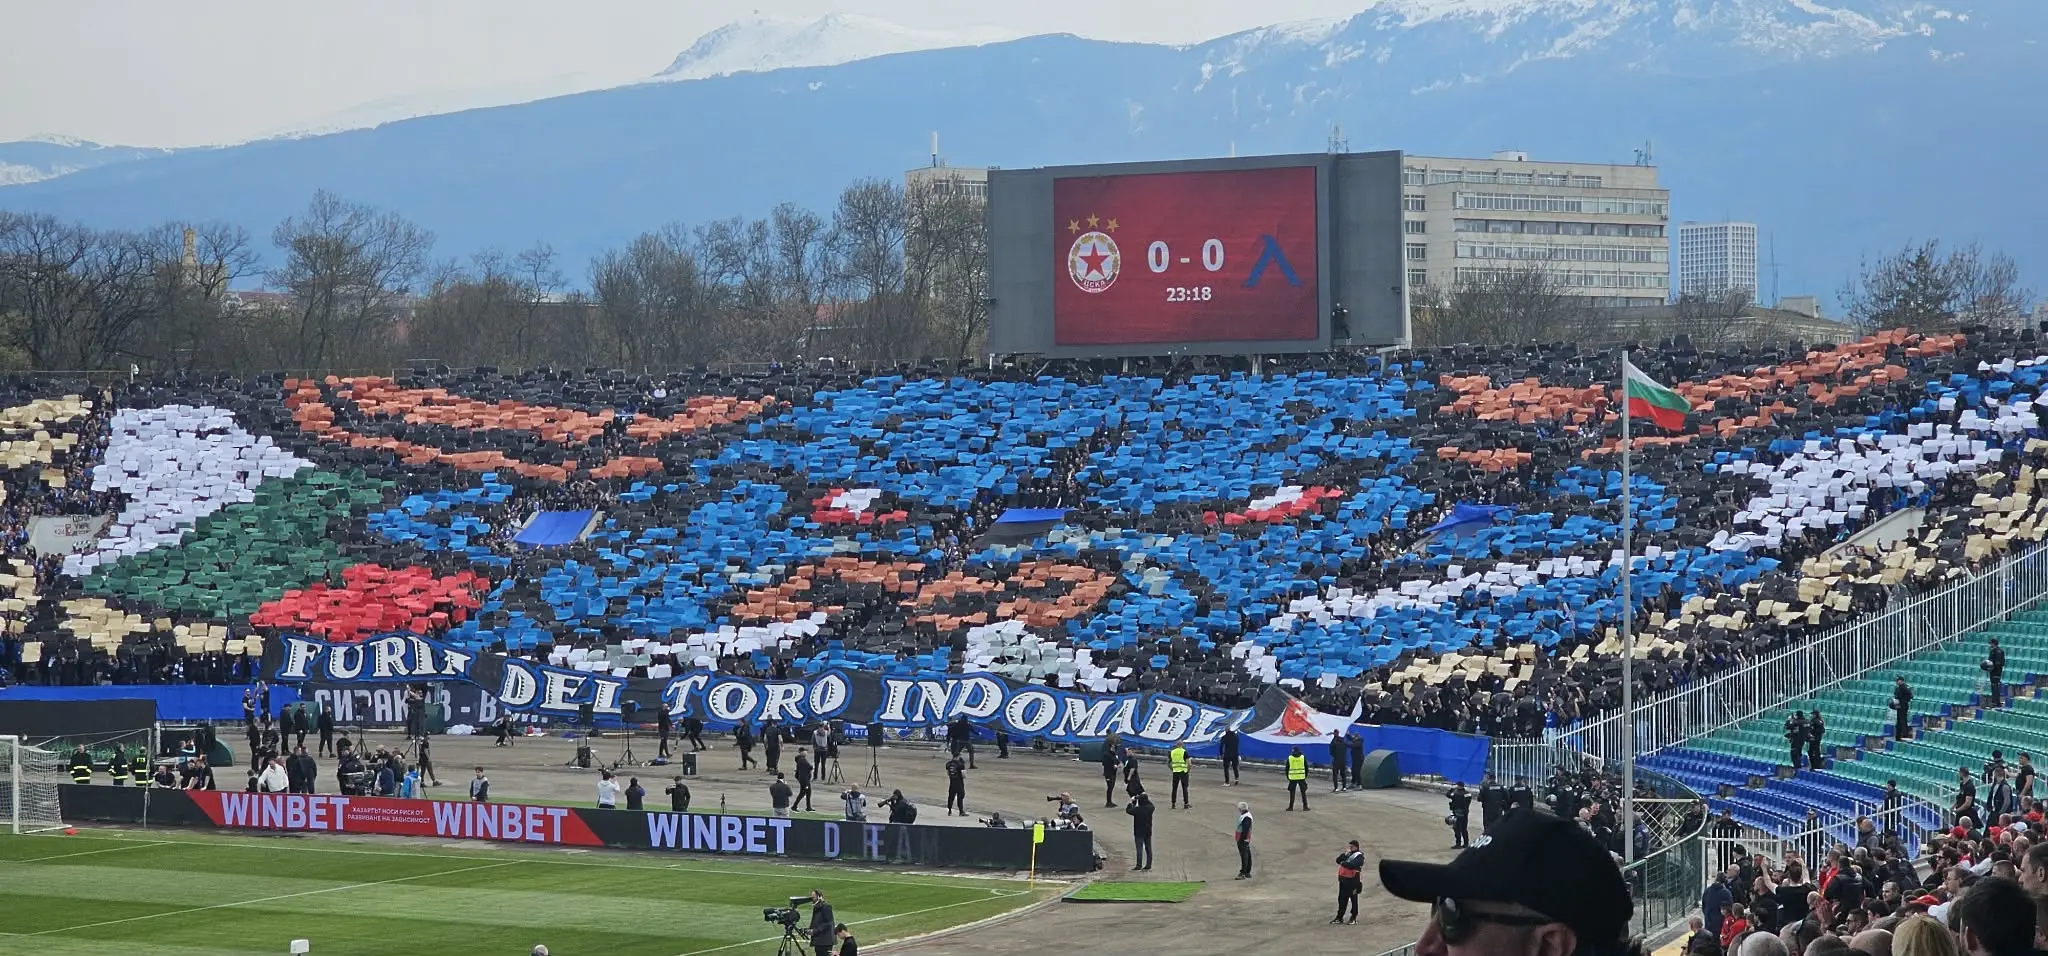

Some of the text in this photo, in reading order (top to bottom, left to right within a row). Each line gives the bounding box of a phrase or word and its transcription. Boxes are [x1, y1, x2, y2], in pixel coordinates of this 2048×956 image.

[1148, 240, 1170, 273] 0
[1202, 238, 1225, 272] 0
[1166, 286, 1212, 302] 23:18
[314, 688, 452, 722] СИРАКВ
[499, 664, 622, 714] DEL
[666, 673, 847, 721] TORO
[880, 677, 1253, 743] INDOMABL
[221, 792, 350, 830] WINBET
[432, 801, 569, 842] WINBET
[647, 812, 792, 855] WINBET
